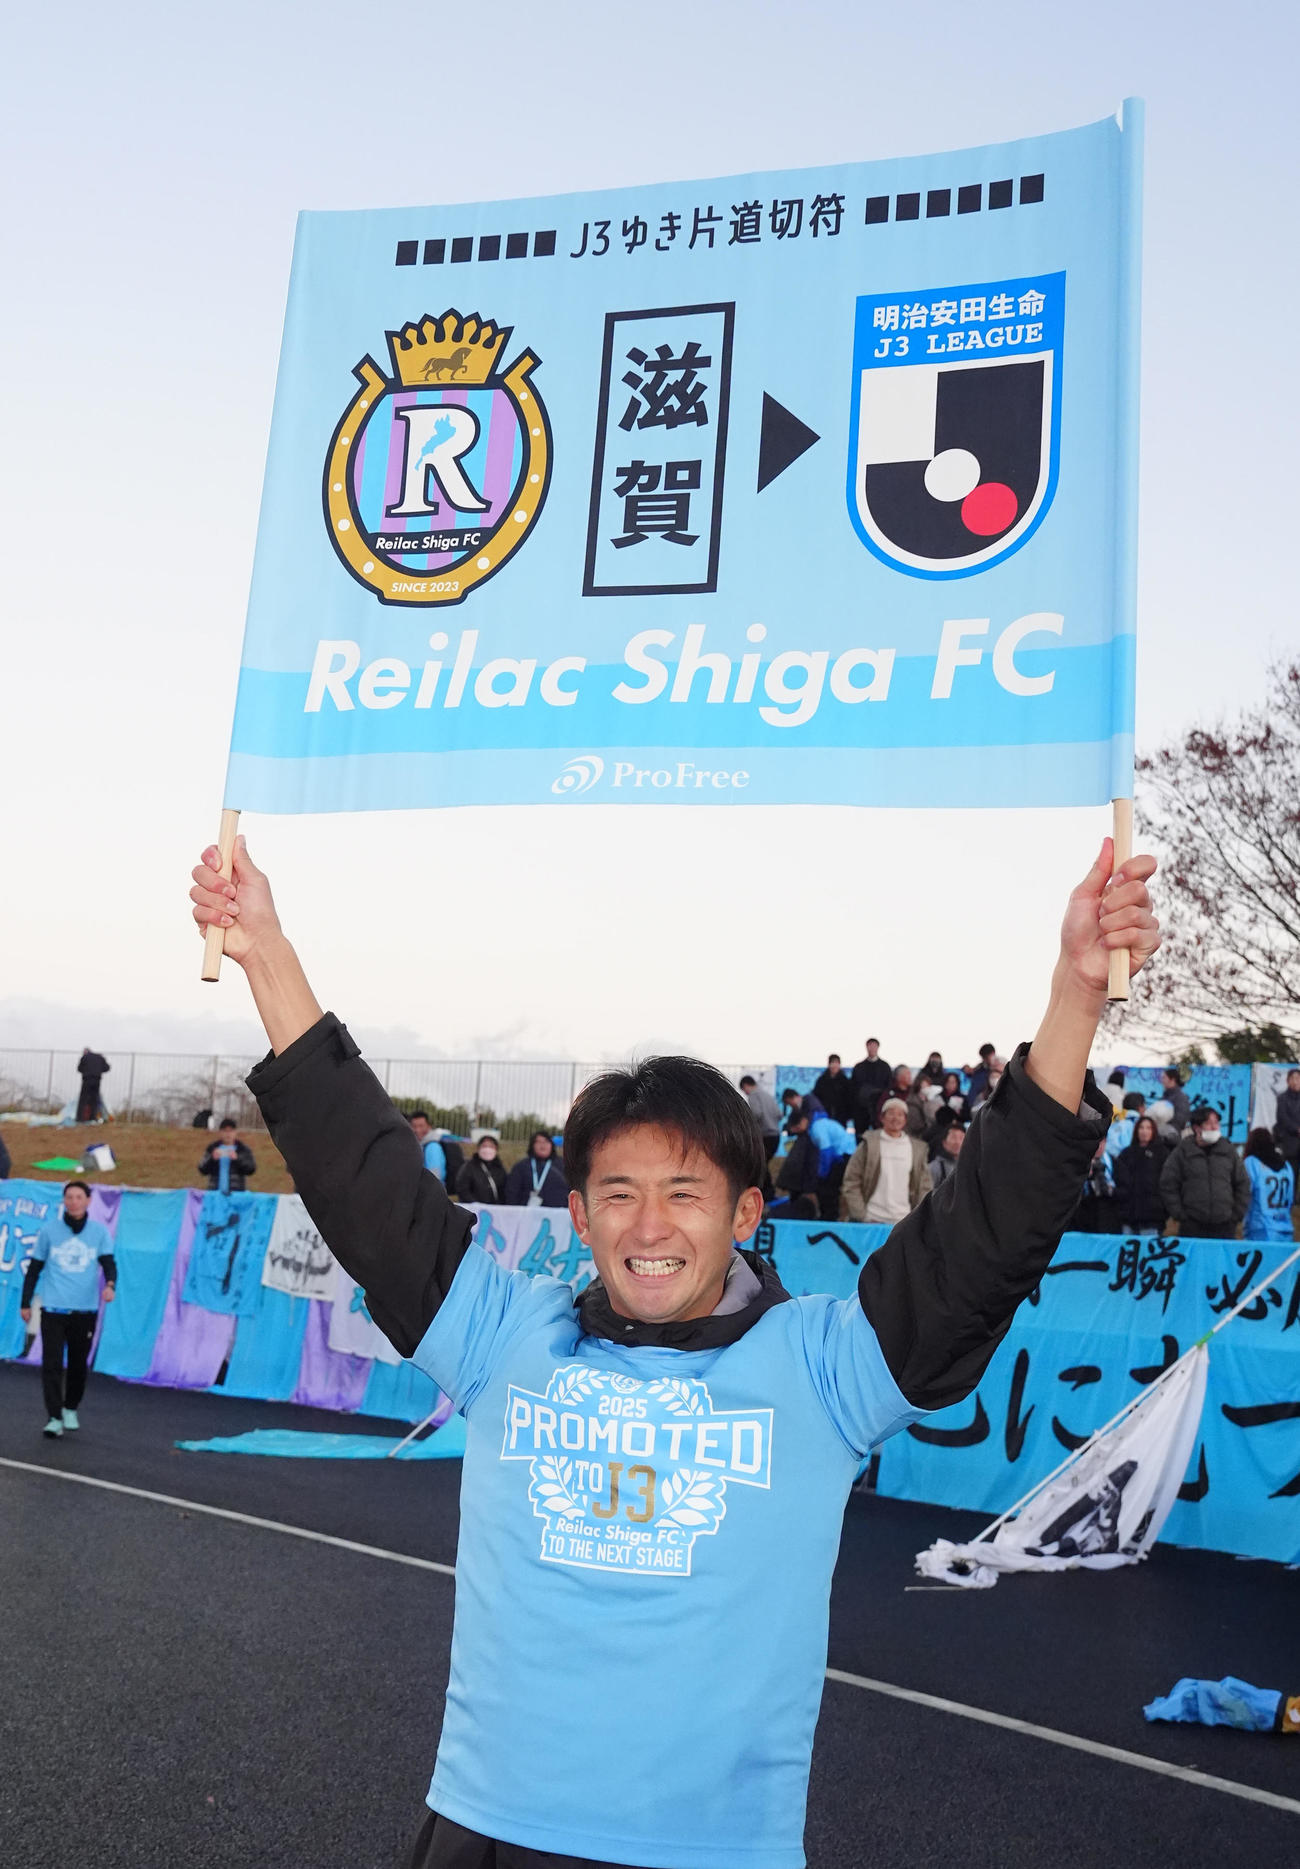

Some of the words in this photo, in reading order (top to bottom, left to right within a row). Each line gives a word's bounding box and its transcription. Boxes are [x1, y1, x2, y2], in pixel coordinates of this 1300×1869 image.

[570, 193, 845, 258] J3ゆき片道切符
[873, 289, 1047, 332] 明治安田生命
[874, 336, 910, 358] J3
[926, 322, 1043, 354] LEAGUE
[387, 406, 490, 515] R
[610, 342, 712, 550] 滋賀
[375, 535, 419, 550] Reilac
[421, 534, 460, 552] Shiga
[462, 533, 481, 547] FC
[391, 582, 427, 593] SINCE
[429, 580, 460, 593] 2023
[304, 630, 587, 713] Reilac
[611, 623, 896, 728] Shiga
[930, 612, 1065, 699] FC
[611, 761, 750, 788] ProFree
[598, 1395, 648, 1418] 2025
[509, 1397, 762, 1474] PROMOTED
[575, 1460, 603, 1493] TO
[592, 1461, 657, 1523] J3
[549, 1534, 565, 1554] TO
[569, 1538, 593, 1560] THE
[596, 1542, 633, 1565] NEXT
[636, 1548, 683, 1568] STAGE
[556, 1518, 601, 1538] Reilac
[604, 1525, 652, 1546] Shiga
[657, 1529, 679, 1545] FC
